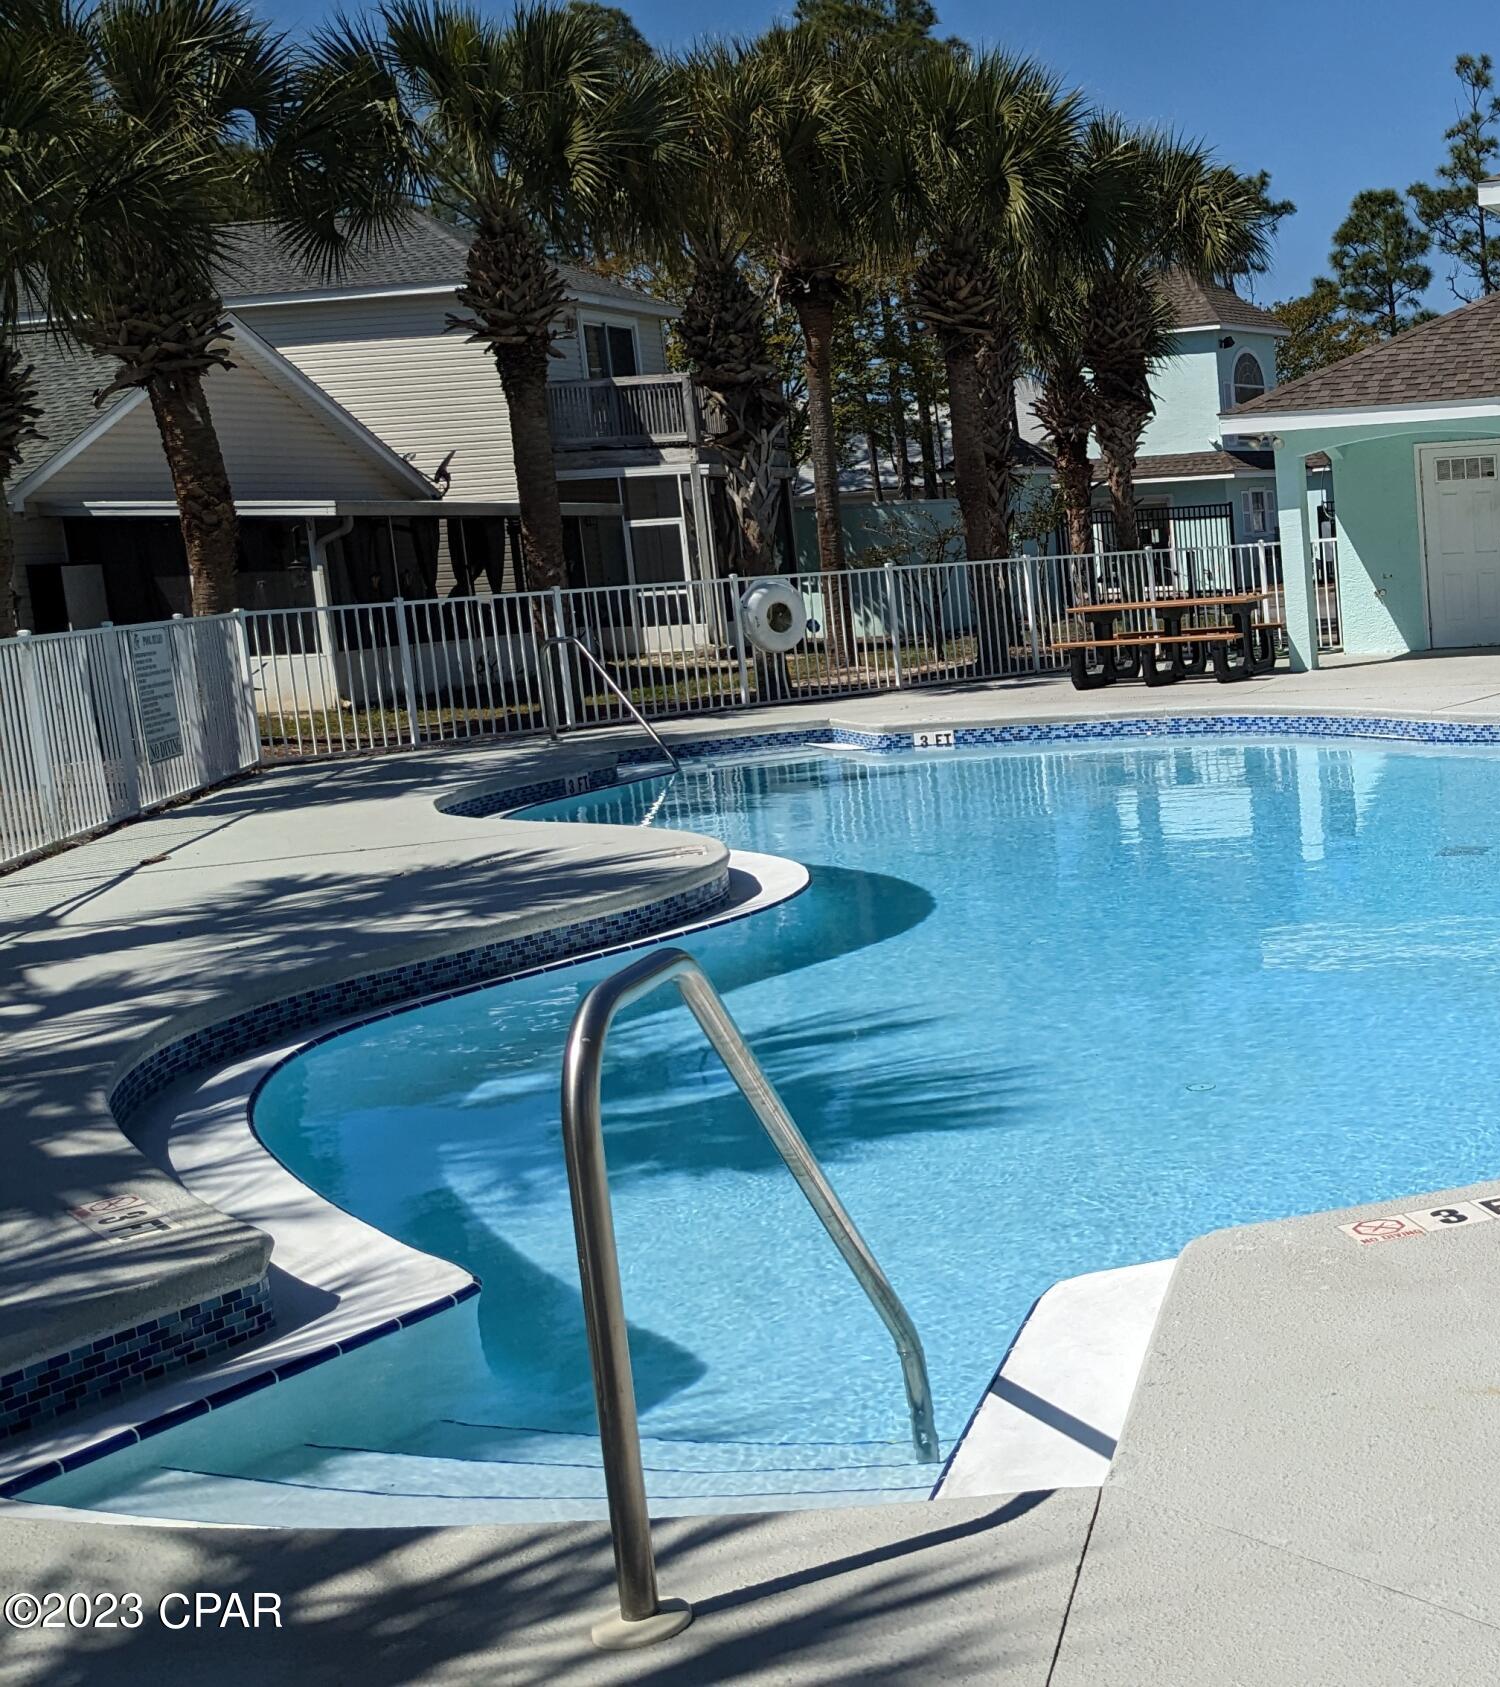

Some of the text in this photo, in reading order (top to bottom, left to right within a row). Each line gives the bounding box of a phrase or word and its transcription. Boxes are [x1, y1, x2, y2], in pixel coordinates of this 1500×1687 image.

[920, 733, 952, 746] 3 FT
[568, 775, 588, 793] 3 FT
[1430, 1208, 1468, 1224] 3
[98, 1210, 171, 1240] 3 FT
